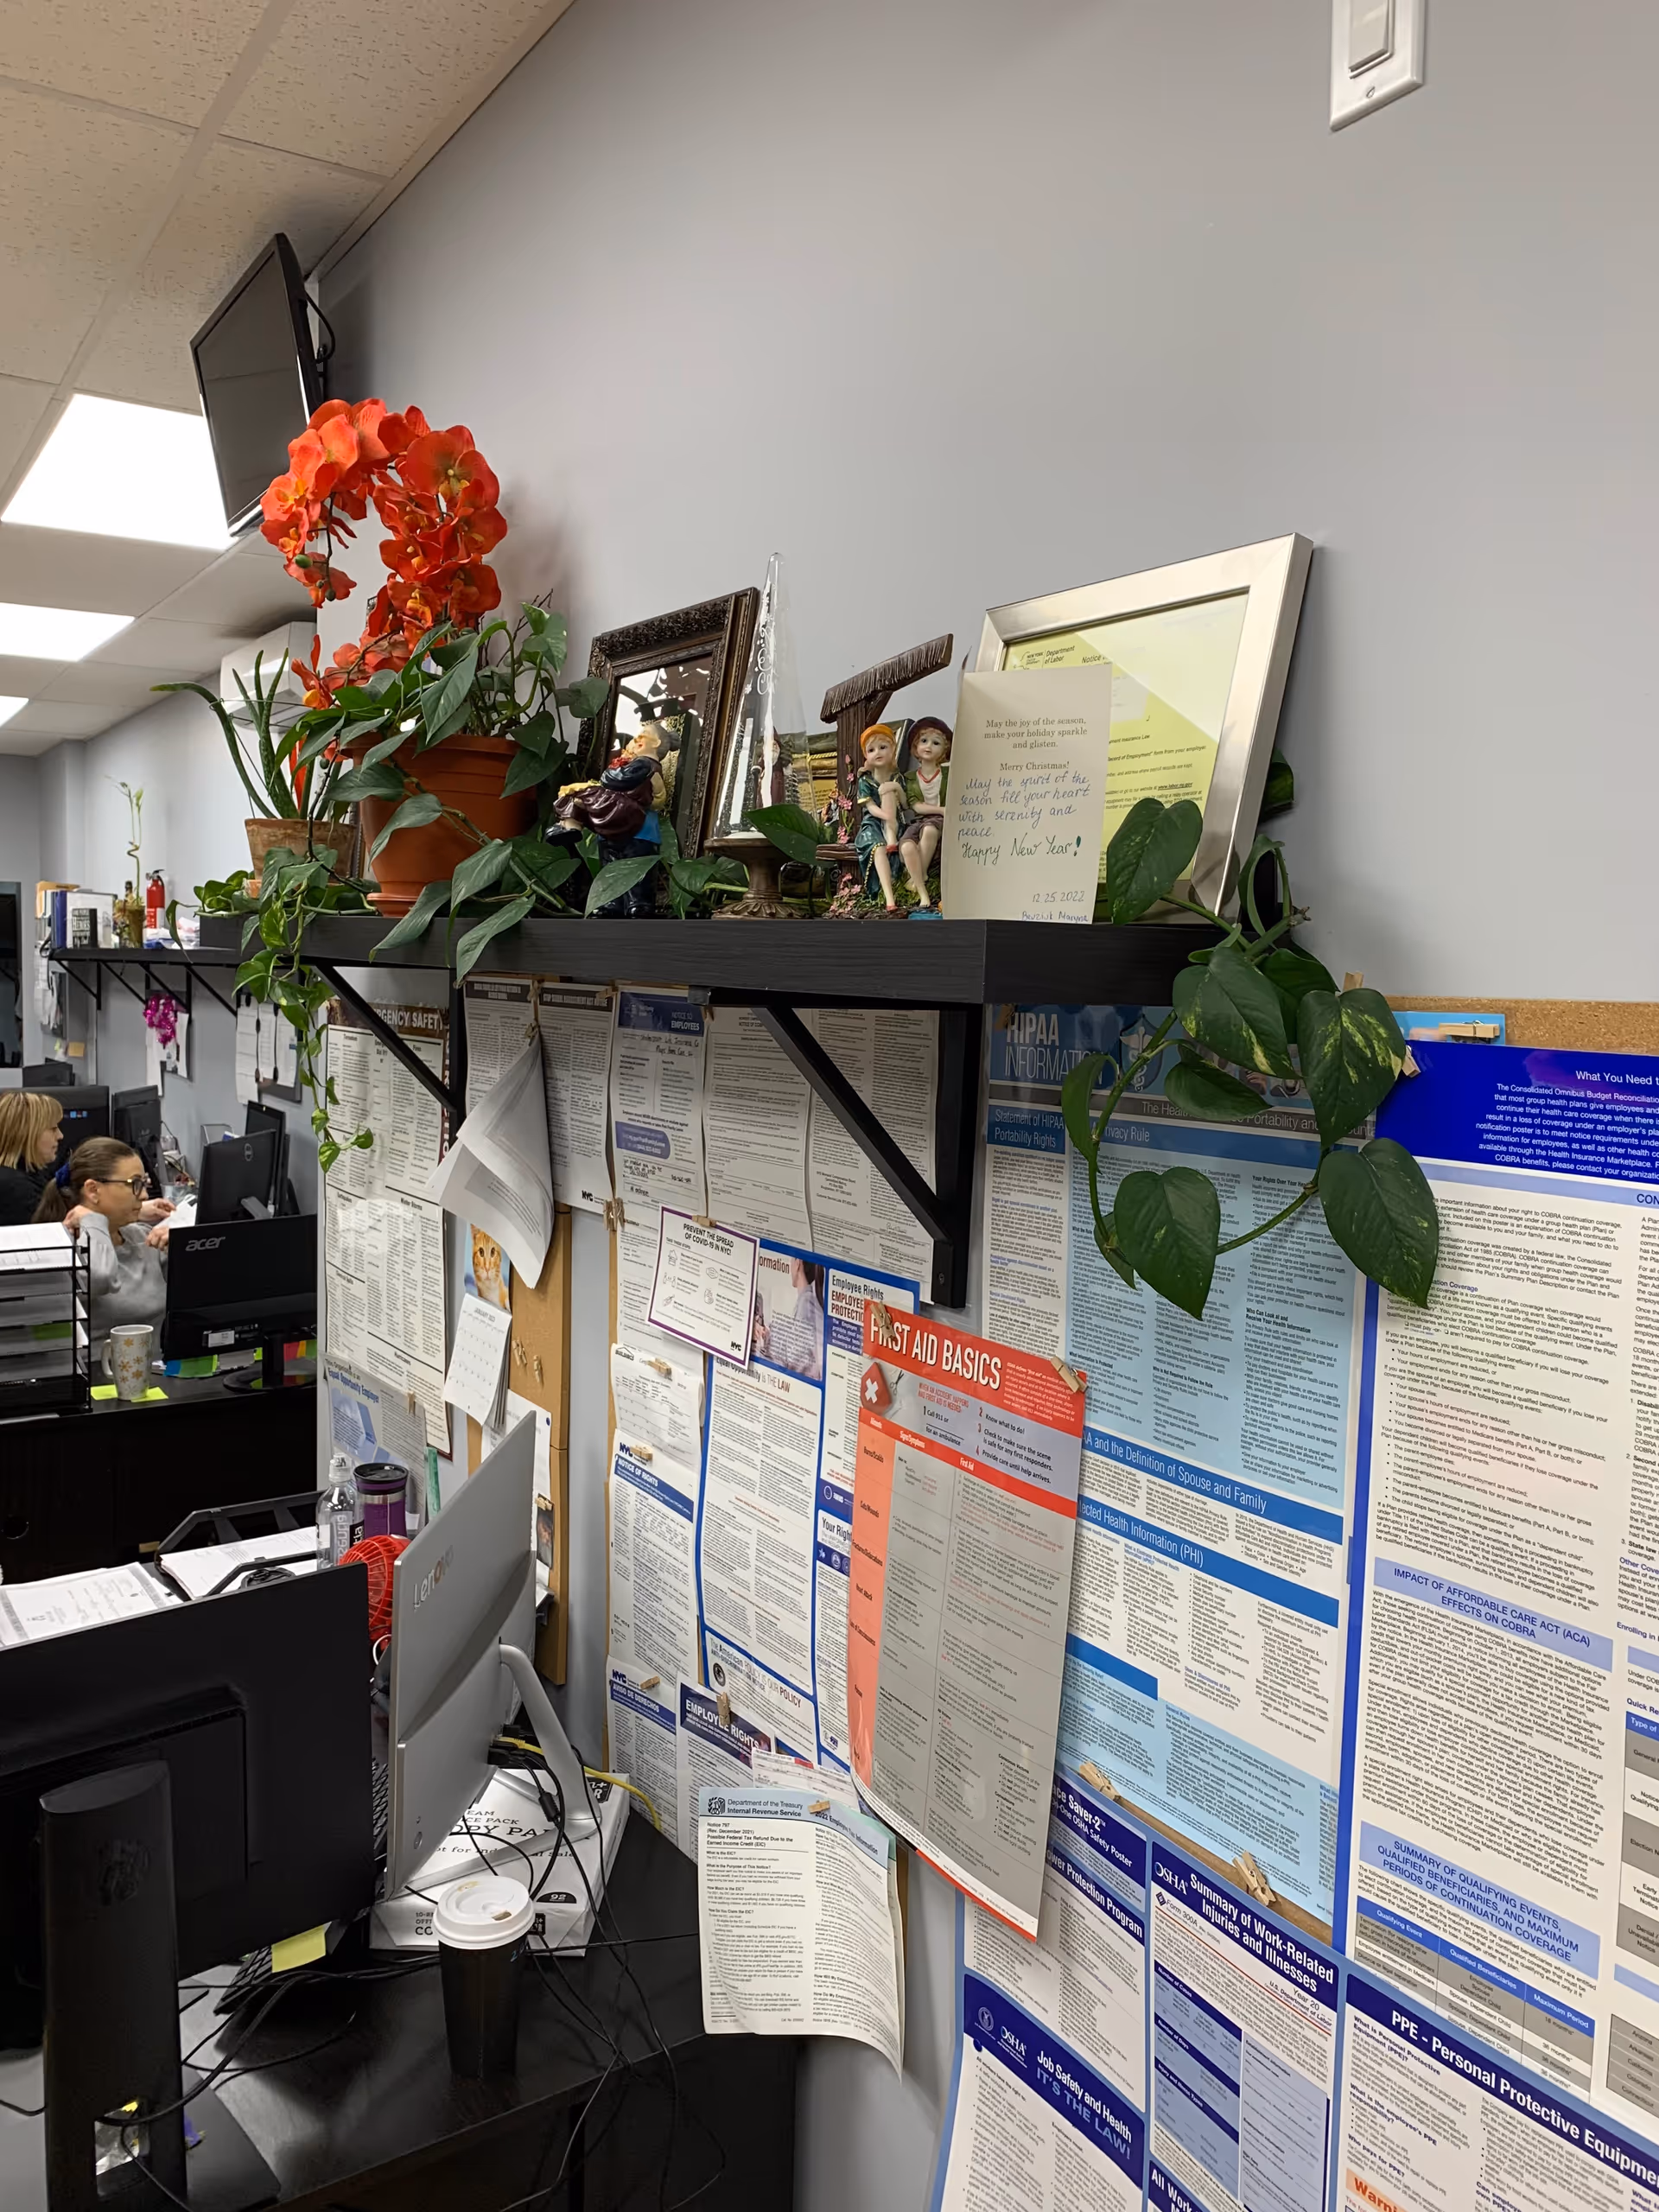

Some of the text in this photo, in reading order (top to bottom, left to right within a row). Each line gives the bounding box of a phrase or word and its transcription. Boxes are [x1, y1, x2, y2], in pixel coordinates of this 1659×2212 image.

[984, 730, 1005, 739] make
[1058, 727, 1087, 737] sparkle
[986, 719, 1002, 728] May
[1019, 719, 1031, 728] joy
[1029, 741, 1058, 749] glisten.
[1000, 761, 1070, 772] Merry Christmas!
[959, 785, 1090, 808] season fill your heart
[966, 771, 1090, 797] May the spirit of the
[995, 807, 1042, 830] serenity
[1050, 804, 1077, 816] and
[963, 832, 1082, 866] Happy New Year!
[671, 1020, 699, 1031] EMPLOYEES
[1006, 1012, 1059, 1046] HIPAA
[1510, 1084, 1553, 1095] Consolidated
[1554, 1088, 1585, 1097] Omnibus
[1586, 1091, 1611, 1100] Budget
[1575, 1071, 1652, 1085] What You Need
[995, 1109, 1032, 1124] Statement
[1033, 1116, 1040, 1125] of
[995, 1127, 1056, 1148] Portability Rights
[185, 1236, 226, 1251] acer
[683, 1224, 734, 1248] PREVENT THE SPREAD
[692, 1235, 714, 1249] COVID-19
[720, 1245, 731, 1255] NYC!
[831, 1290, 863, 1309] EMPLOYEE
[832, 1274, 884, 1300] Employee Rights
[912, 1330, 938, 1365] AID
[942, 1339, 1001, 1390] BASICS
[923, 1406, 926, 1415] 1
[979, 1407, 983, 1417] 2
[985, 1414, 998, 1425] Know
[999, 1420, 1010, 1429] what
[1016, 1425, 1025, 1434] do!
[938, 1431, 961, 1446] ambulance
[977, 1423, 982, 1433] 3
[984, 1428, 996, 1439] Check
[1003, 1437, 1015, 1447] make
[1016, 1441, 1027, 1451] sure
[1027, 1446, 1036, 1455] the
[1037, 1451, 1051, 1461] scene
[976, 1446, 1052, 1484] 4 Provide care until help arrives.
[988, 1439, 996, 1448] safe
[1005, 1447, 1014, 1456] any
[1014, 1450, 1023, 1460] first
[1024, 1455, 1053, 1471] responders.
[1095, 1438, 1267, 1515] and the Definition of Spouse and Family
[1104, 1509, 1204, 1568] Health Information (PHI)
[1394, 1567, 1591, 1648] IMPACT OF AFFORDABLE CARE ACT (ACA)
[1441, 1596, 1536, 1639] EFFECTS ON COBRA
[685, 1699, 760, 1749] EMPLOYE RIGHTS
[780, 1802, 803, 1810] Treasury
[1073, 1815, 1133, 1867] OSHA Safety Poster
[1154, 1862, 1187, 1895] OSHA
[1394, 1840, 1562, 1932] SUMMARY OF QUALIFYING EVENTS,
[1067, 1863, 1142, 1938] Protection Program
[1190, 1872, 1333, 1985] Summary of Work-Related
[1202, 1899, 1317, 1993] Injuries and Illnesses
[1000, 2025, 1027, 2056] OSHA
[1037, 2050, 1131, 2143] Job Safety and Health
[1392, 2010, 1419, 2041] PPE
[1432, 2036, 1496, 2089] Personal
[1500, 2076, 1580, 2139] Protective
[1585, 2127, 1659, 2186] Equipme
[1037, 2067, 1130, 2160] IT'S THE LAW!
